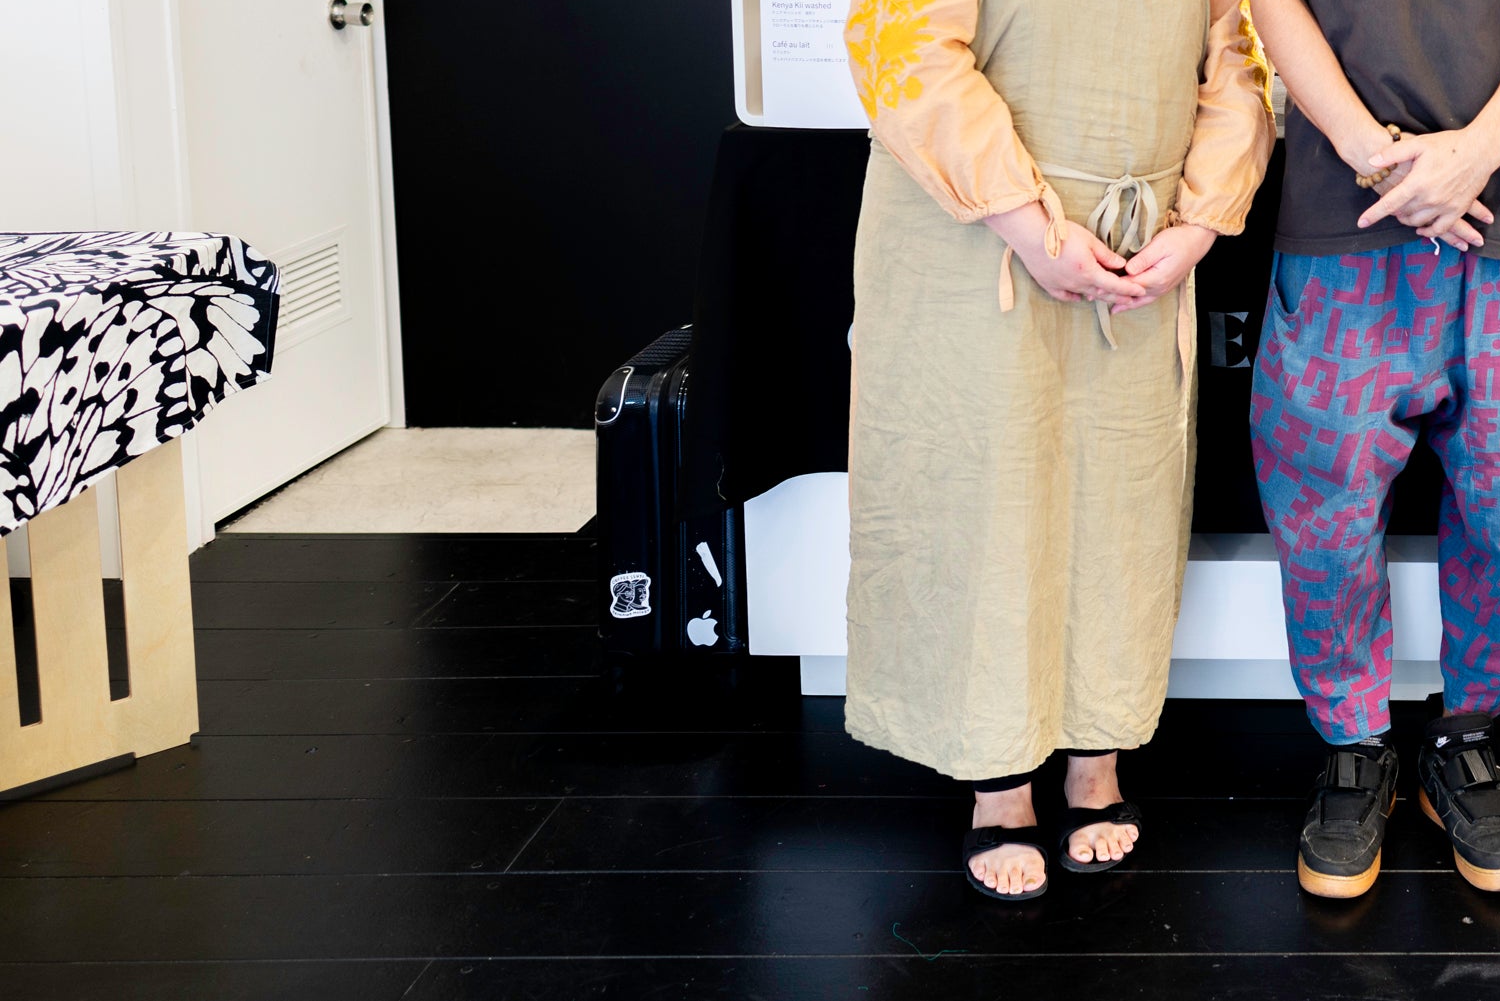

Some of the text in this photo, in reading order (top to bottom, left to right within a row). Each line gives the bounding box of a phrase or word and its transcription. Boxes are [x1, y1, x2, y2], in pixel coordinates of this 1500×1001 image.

[771, 1, 793, 10] Kenya
[772, 40, 787, 48] Café
[799, 41, 810, 49] lait
